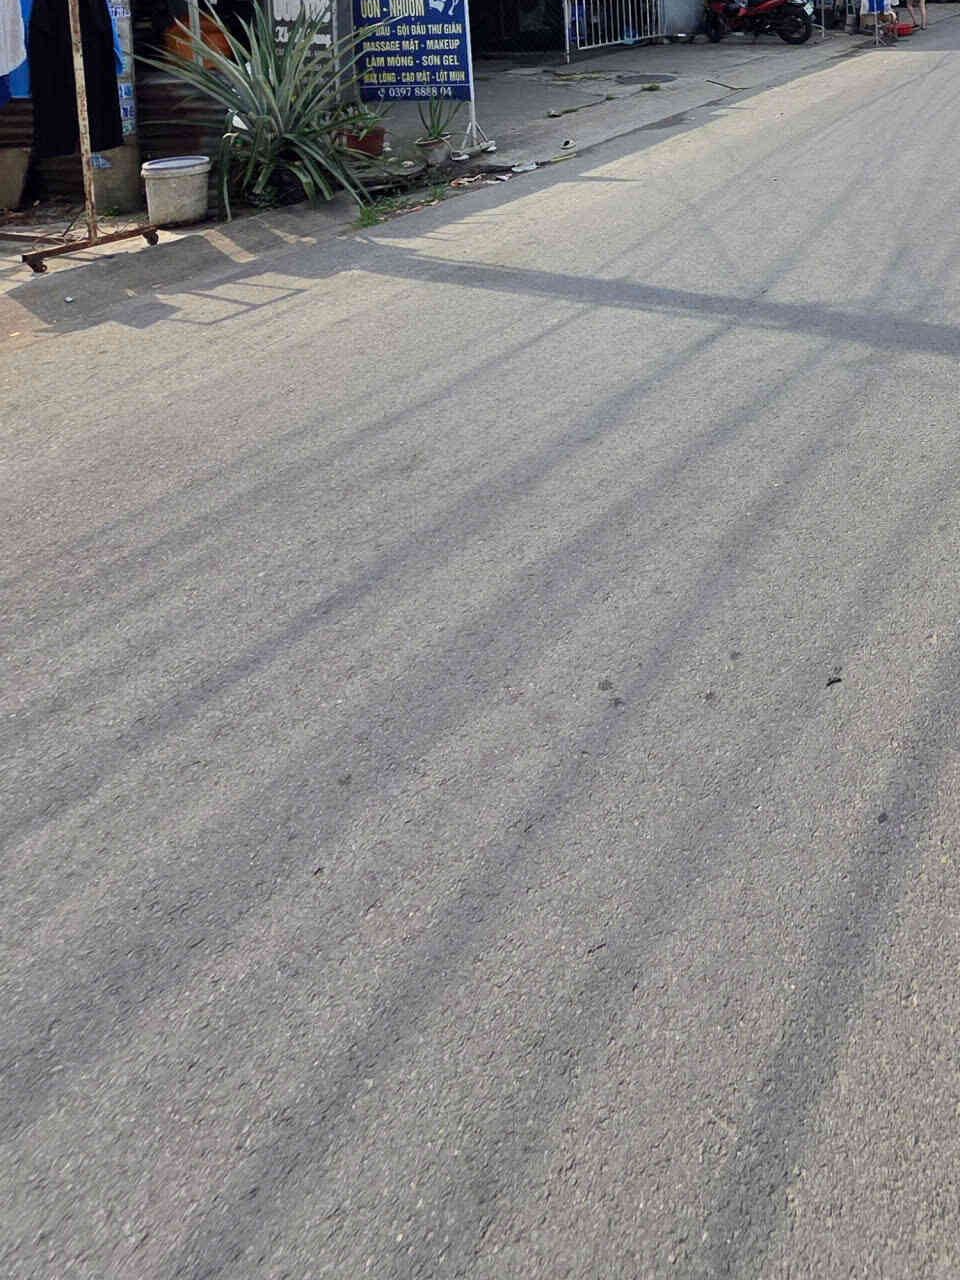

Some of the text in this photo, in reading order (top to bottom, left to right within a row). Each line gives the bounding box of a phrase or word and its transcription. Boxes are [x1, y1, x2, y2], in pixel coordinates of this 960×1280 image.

[363, 40, 400, 51] MASSAGE
[426, 39, 461, 50] MAKEUP
[443, 55, 460, 65] GEL
